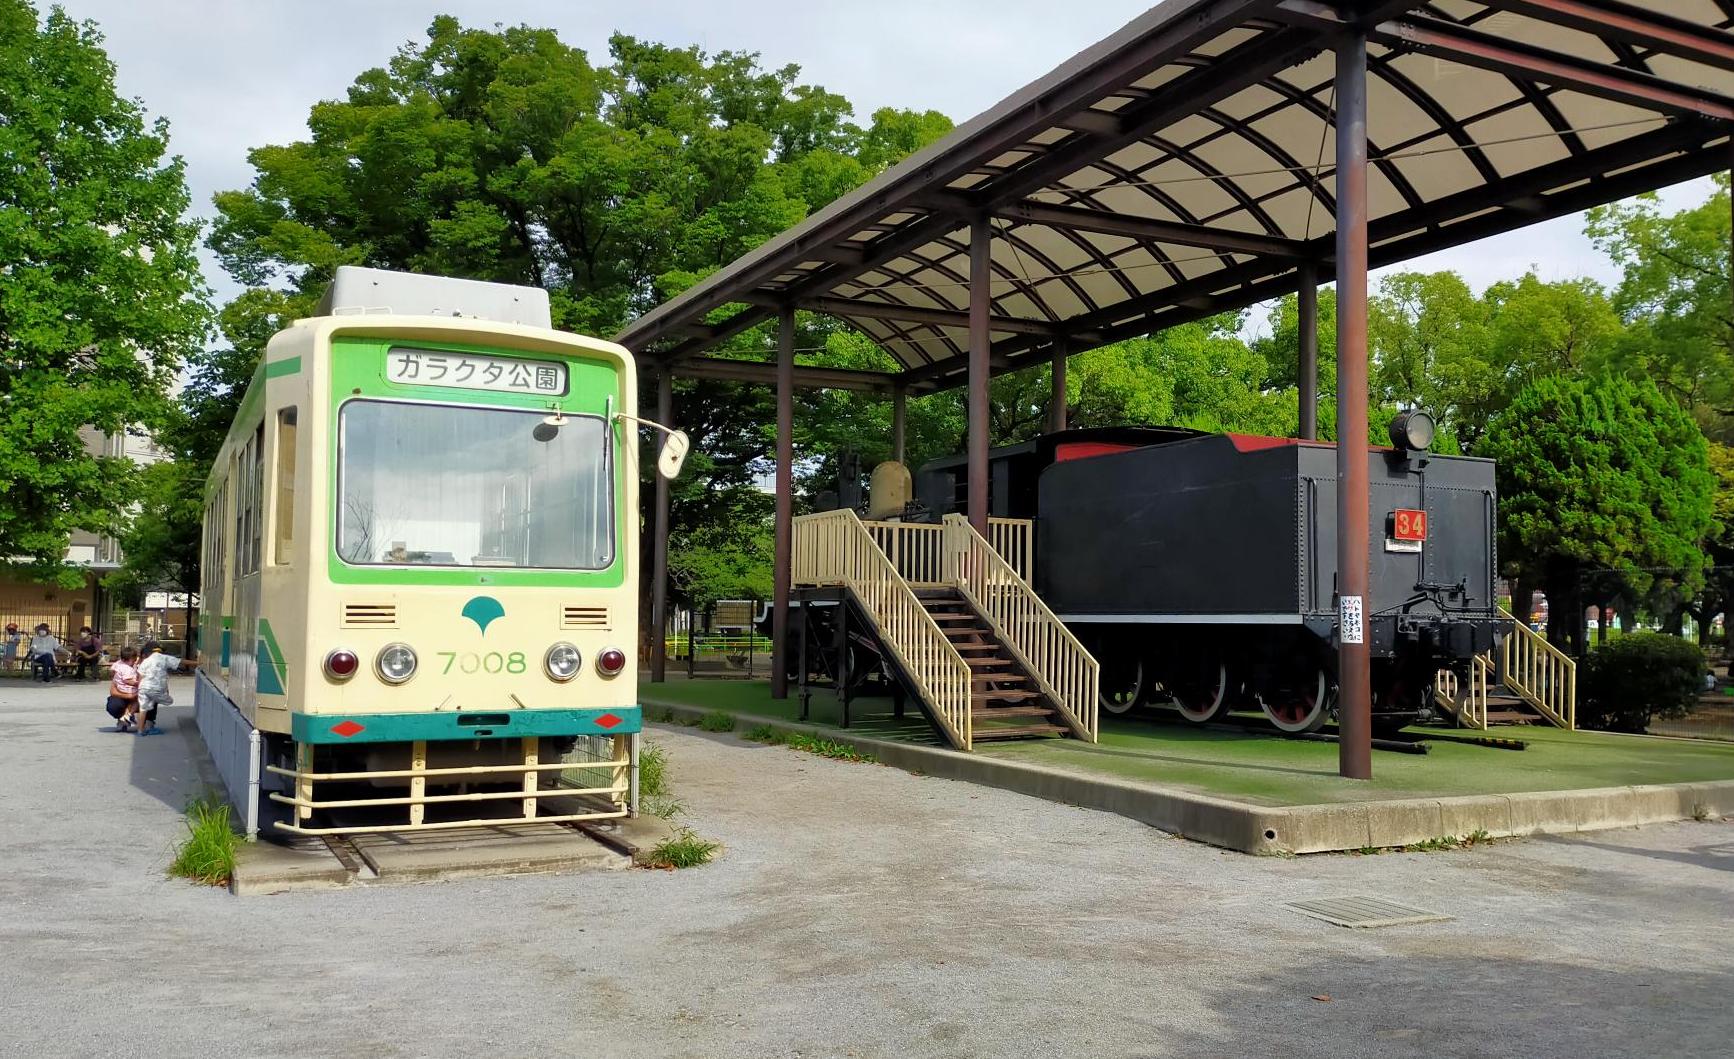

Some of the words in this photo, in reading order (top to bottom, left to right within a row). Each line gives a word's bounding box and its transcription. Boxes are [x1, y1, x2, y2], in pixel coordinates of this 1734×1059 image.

[398, 354, 558, 391] ガラクタ公園
[1398, 513, 1423, 536] 34
[436, 651, 527, 675] 7008
